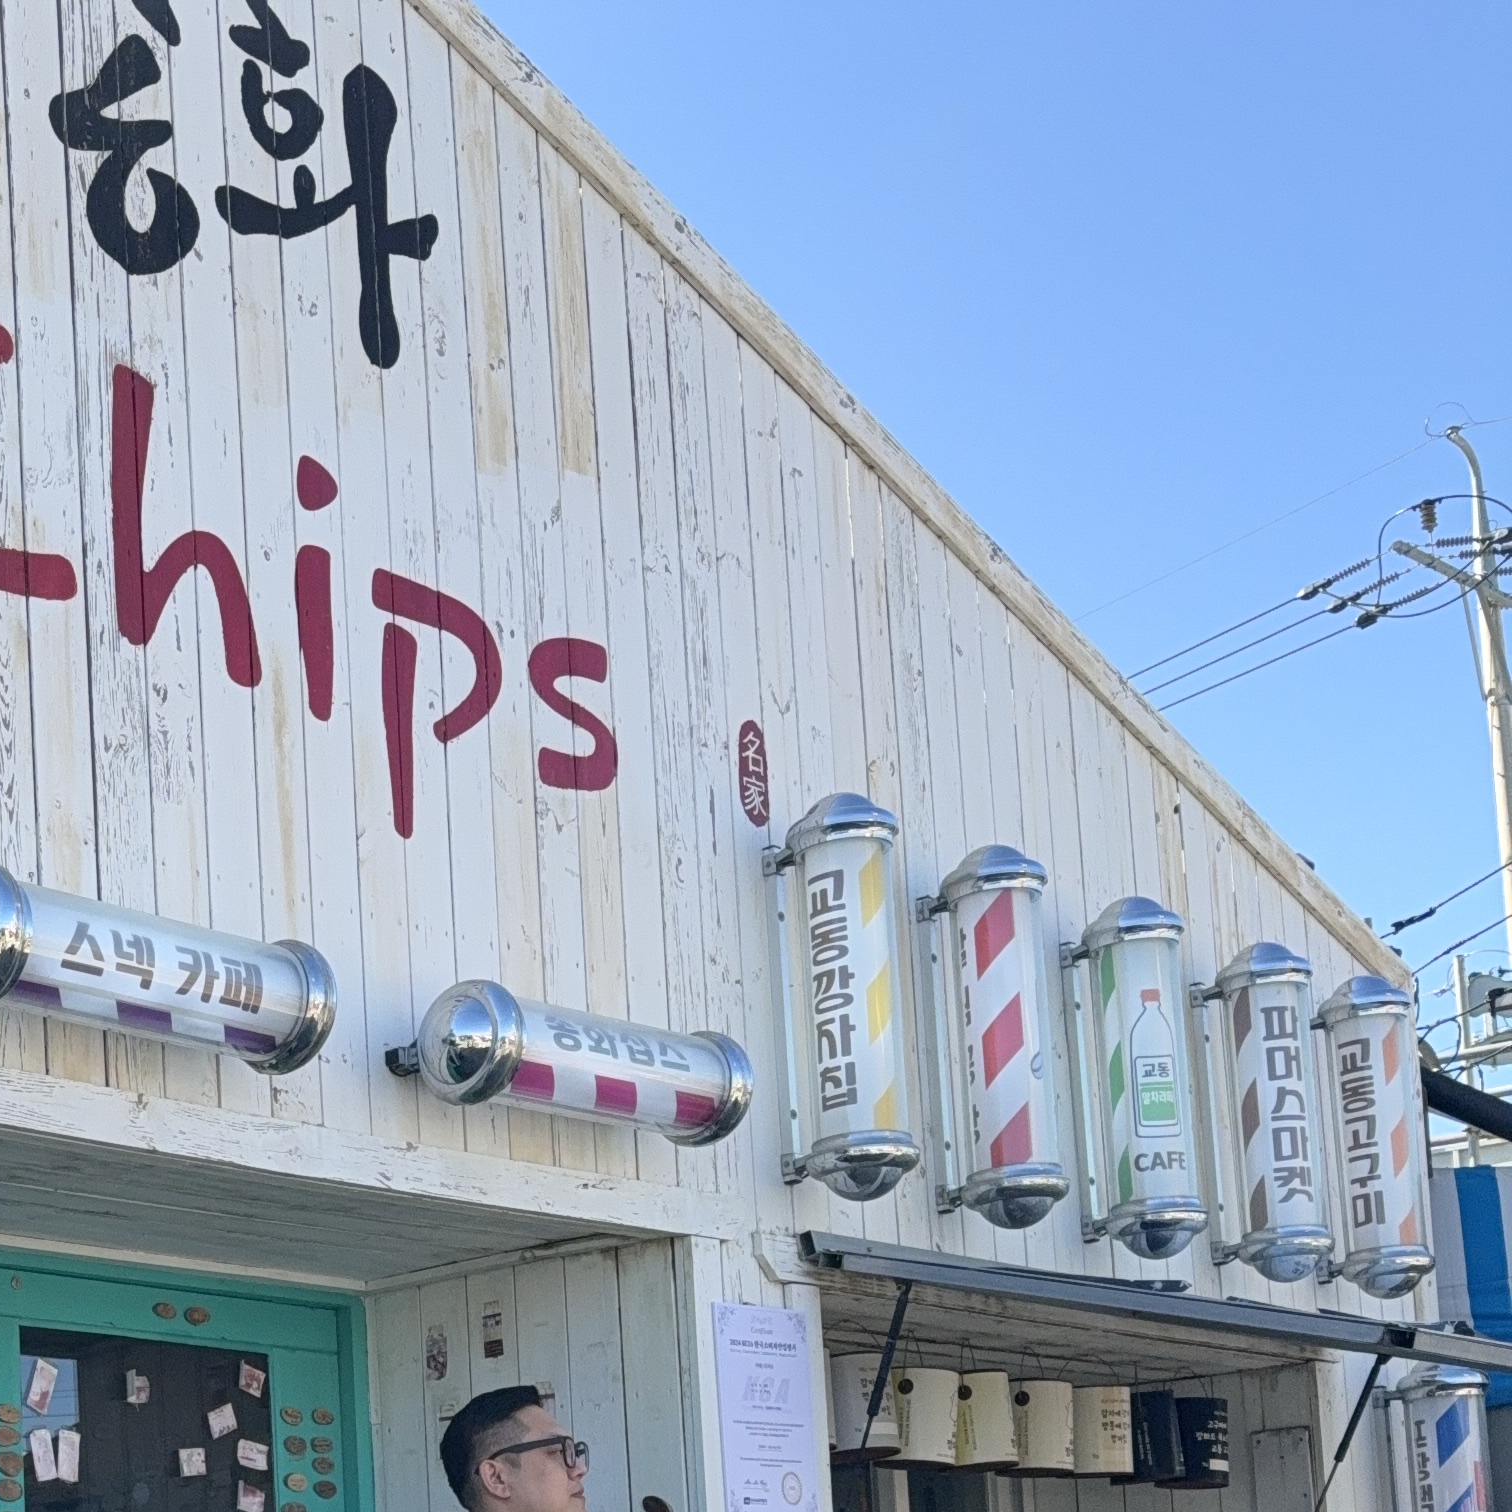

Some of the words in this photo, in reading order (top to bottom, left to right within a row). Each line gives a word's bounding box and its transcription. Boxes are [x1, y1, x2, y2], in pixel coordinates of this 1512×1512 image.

[49, 0, 438, 369] 송화
[741, 731, 768, 822] 名家
[61, 920, 156, 990] 스넥
[175, 945, 263, 1014] 카페
[807, 868, 859, 1112] 교동깡자칩
[1142, 1062, 1170, 1078] 교동
[1261, 1005, 1314, 1203] 파머스마켓
[1337, 1038, 1386, 1228] 교동고구마
[1134, 1151, 1186, 1173] CAFE
